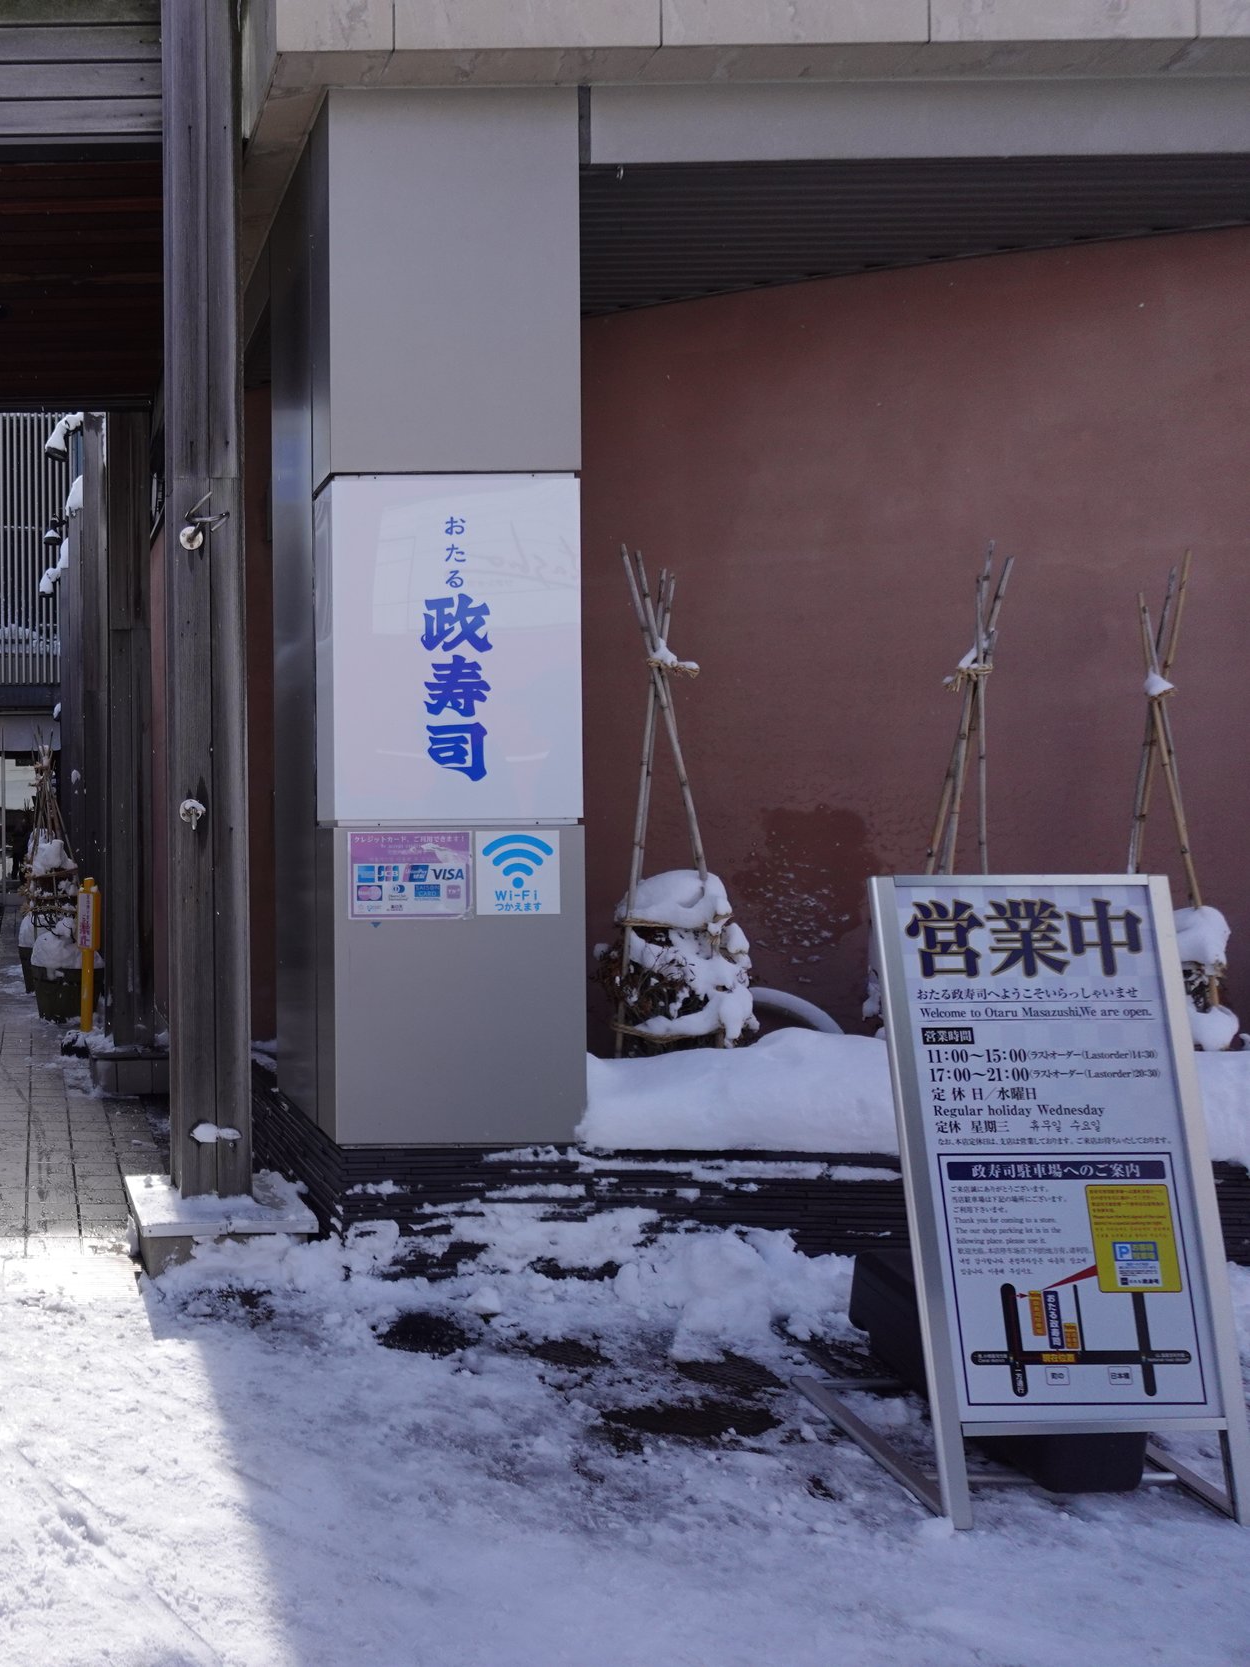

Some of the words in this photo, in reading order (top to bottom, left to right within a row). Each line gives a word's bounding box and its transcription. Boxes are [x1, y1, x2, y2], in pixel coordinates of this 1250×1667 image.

[444, 515, 467, 589] おたる
[420, 593, 494, 782] 政寿司
[430, 868, 465, 880] VISA
[494, 890, 538, 901] Wi-Fi
[494, 902, 542, 912] つかえます
[904, 898, 1143, 980] 営業中
[917, 987, 1139, 1000] おたる政寿司へようこそいらっしゃいませ
[920, 1007, 967, 1018] Welcome
[970, 1008, 982, 1018] to
[985, 1007, 1018, 1018] Otaru
[1100, 1009, 1120, 1017] are
[1122, 1008, 1153, 1019] open.
[924, 1030, 973, 1043] 営業時間
[934, 1104, 984, 1118] Regular
[988, 1104, 1032, 1118] holiday
[1037, 1104, 1105, 1118] Wednesday
[935, 1121, 962, 1134] 定休
[970, 1120, 1010, 1133] 星期三
[1029, 1120, 1062, 1132] 휴무일
[1070, 1120, 1102, 1132] 수요일
[971, 1162, 1141, 1178] 政寿司駐車場へのご案内
[1000, 1217, 1024, 1225] coming
[982, 1227, 997, 1235] shop
[999, 1227, 1024, 1235] parking
[956, 1237, 985, 1245] following
[1005, 1237, 1026, 1245] please
[1117, 1245, 1130, 1258] P
